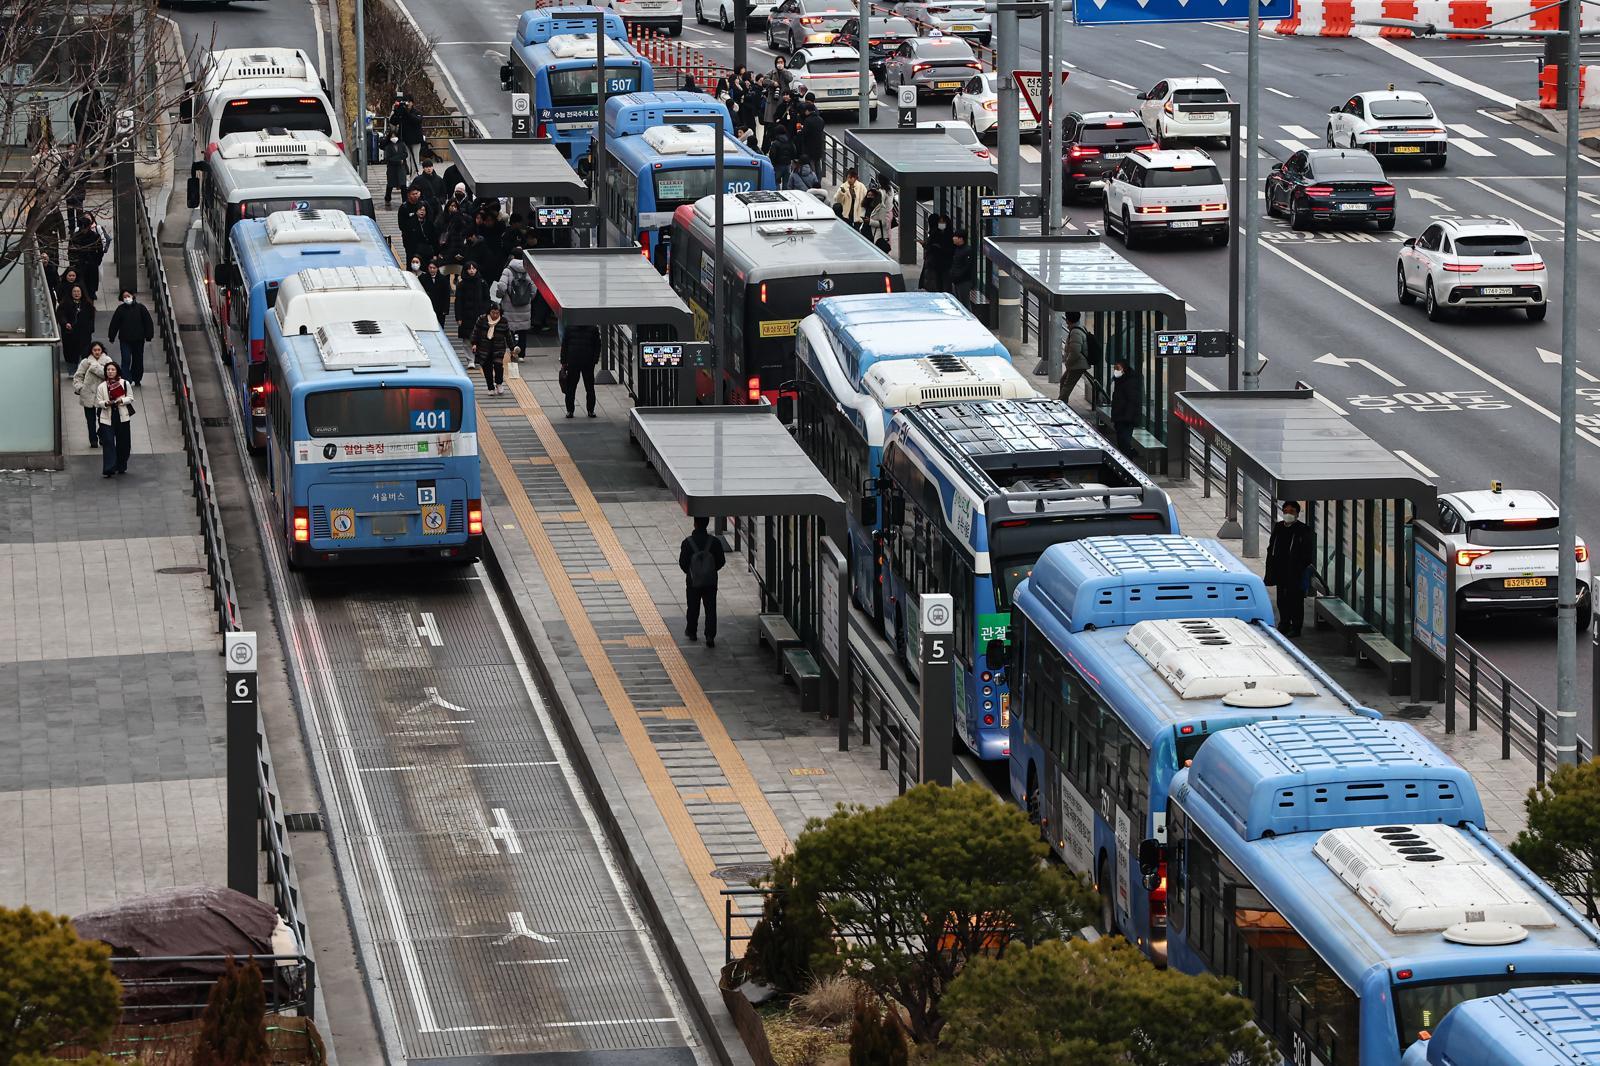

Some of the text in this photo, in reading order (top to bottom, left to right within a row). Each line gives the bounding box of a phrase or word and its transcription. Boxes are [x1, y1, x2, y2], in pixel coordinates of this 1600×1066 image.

[611, 79, 632, 91] 507
[554, 111, 566, 119] 수능
[566, 110, 589, 118] 전국수석
[904, 111, 913, 122] 4
[517, 119, 525, 130] 5
[727, 182, 751, 195] 502
[1346, 390, 1513, 414] 후암동
[416, 411, 446, 429] 401
[344, 443, 365, 456] 혈압
[366, 442, 385, 454] 측정
[371, 492, 405, 502] 서울버스
[420, 489, 433, 503] B
[1526, 577, 1544, 586] 9156
[980, 626, 1006, 642] 관절
[932, 640, 944, 659] 5
[235, 679, 249, 698] 6
[1293, 1031, 1306, 1066] 503
